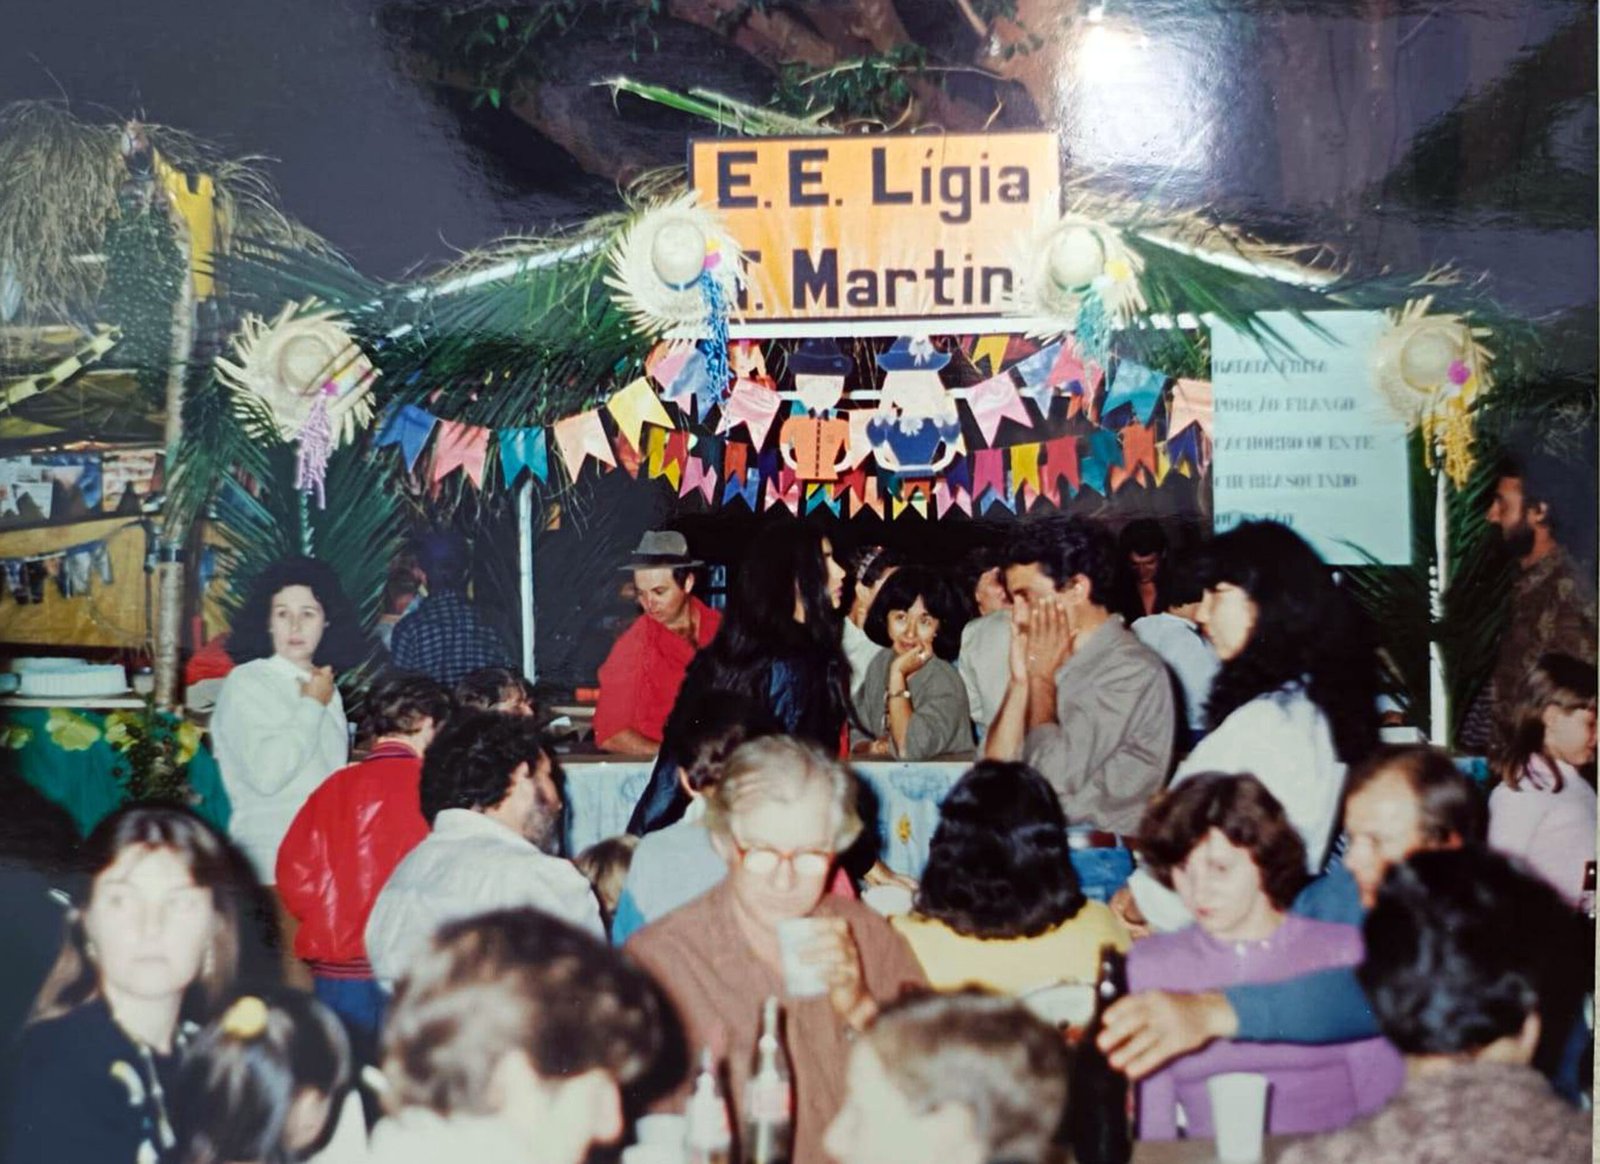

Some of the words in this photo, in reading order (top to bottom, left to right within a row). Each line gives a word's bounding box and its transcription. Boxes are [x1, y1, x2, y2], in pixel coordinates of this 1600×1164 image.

[717, 150, 772, 209] E.
[788, 148, 843, 208] E.
[871, 146, 1030, 224] Lígia
[792, 247, 1015, 310] Martin
